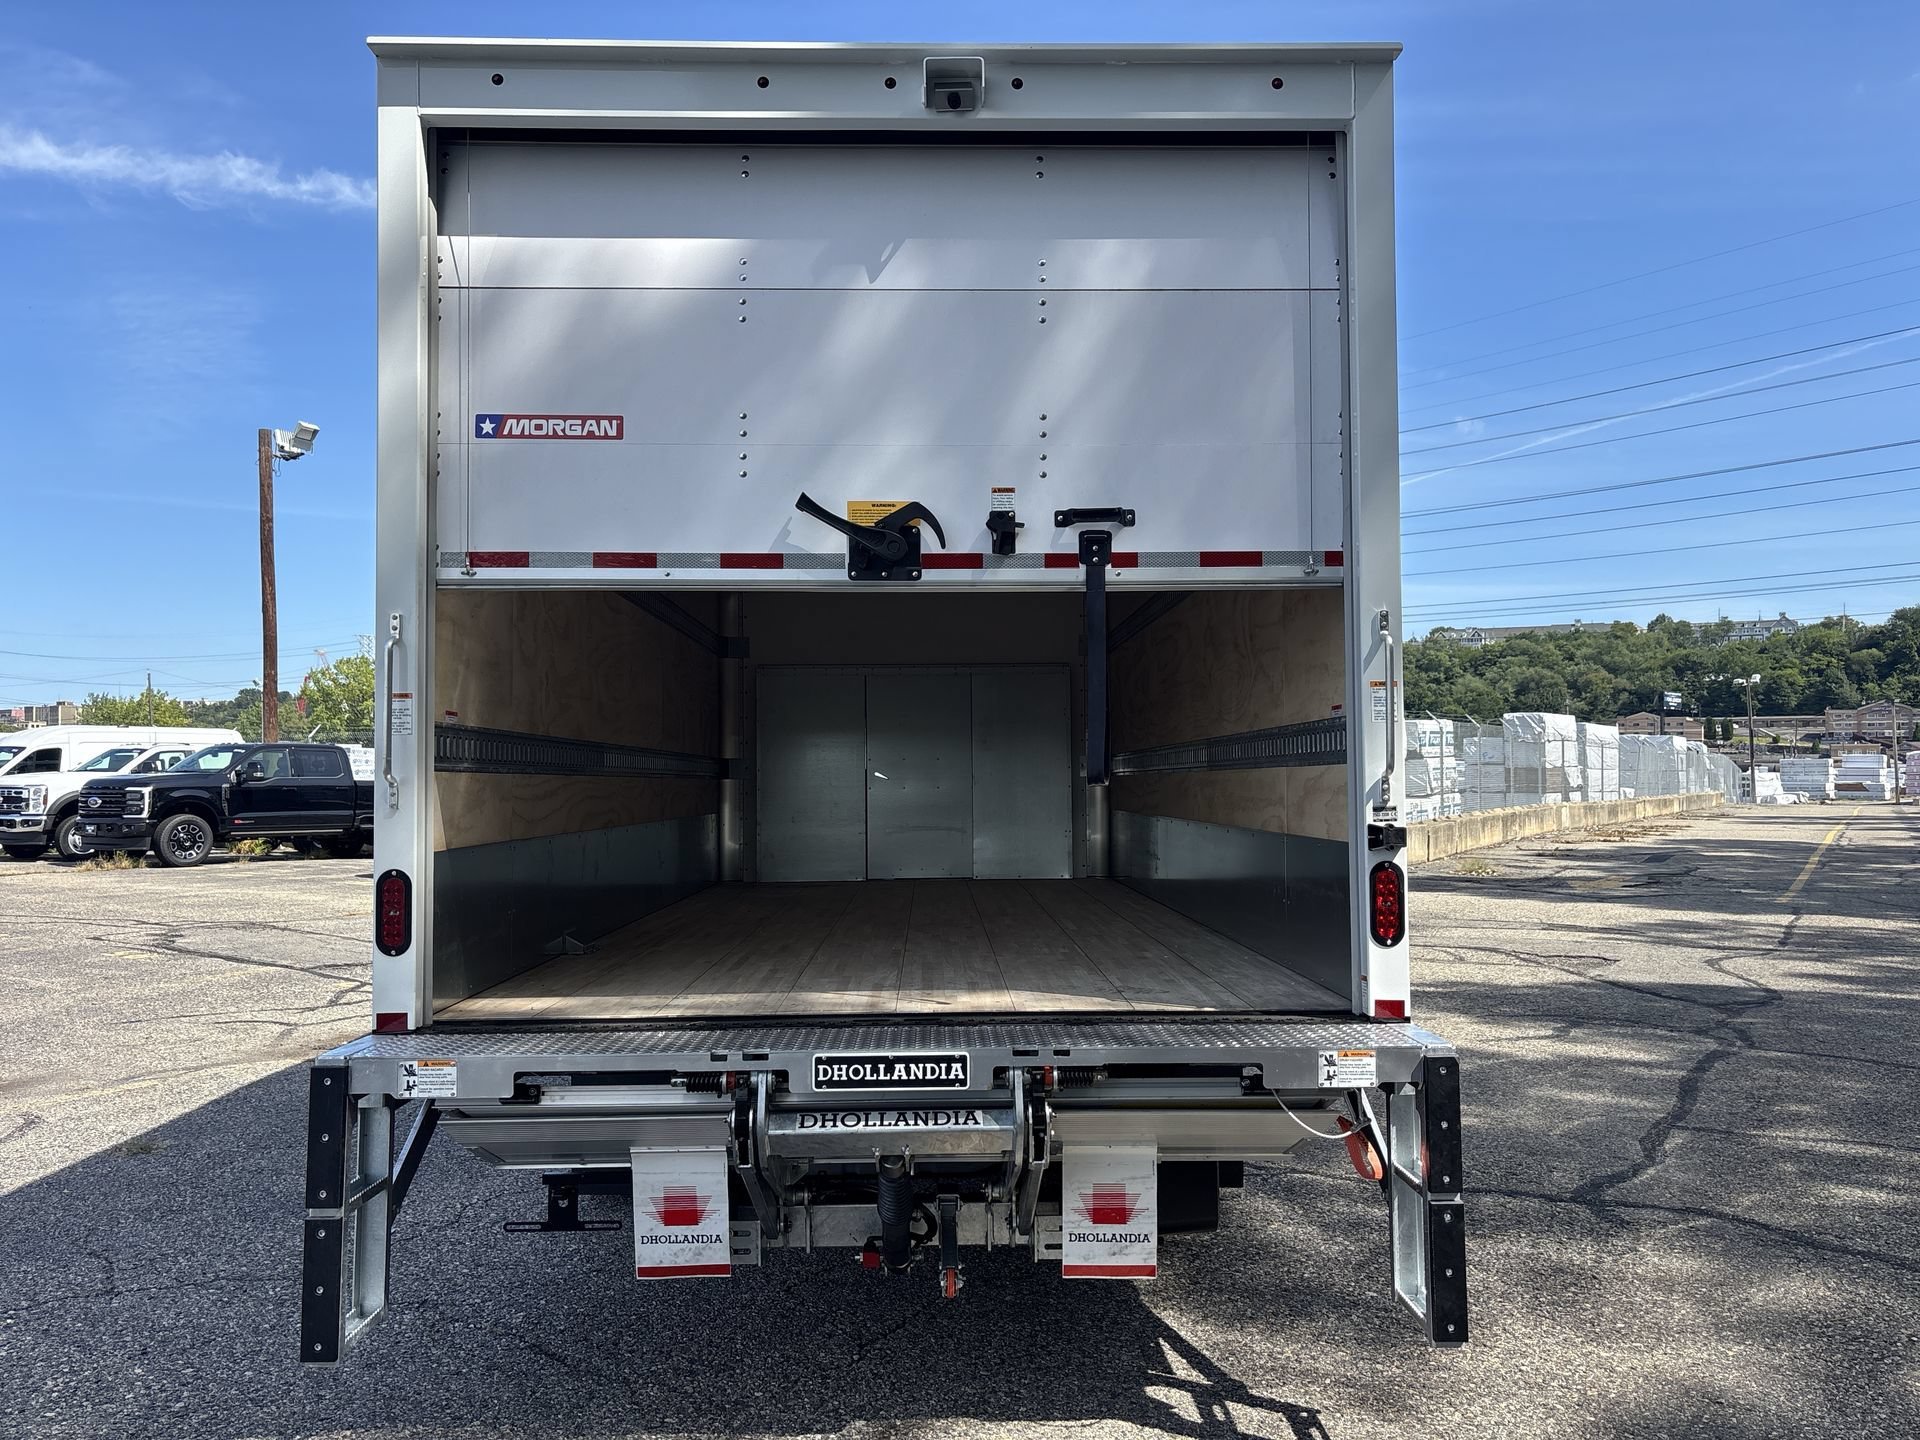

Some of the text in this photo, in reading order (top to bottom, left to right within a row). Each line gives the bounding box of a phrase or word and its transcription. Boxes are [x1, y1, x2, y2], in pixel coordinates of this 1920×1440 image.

[502, 418, 617, 437] MORGAN
[817, 1063, 965, 1081] DHOLLANDIA
[798, 1110, 981, 1128] DHOLLANDIA
[640, 1234, 723, 1245] DHOLLANDIA
[1068, 1232, 1151, 1243] DHOLLANDIA
